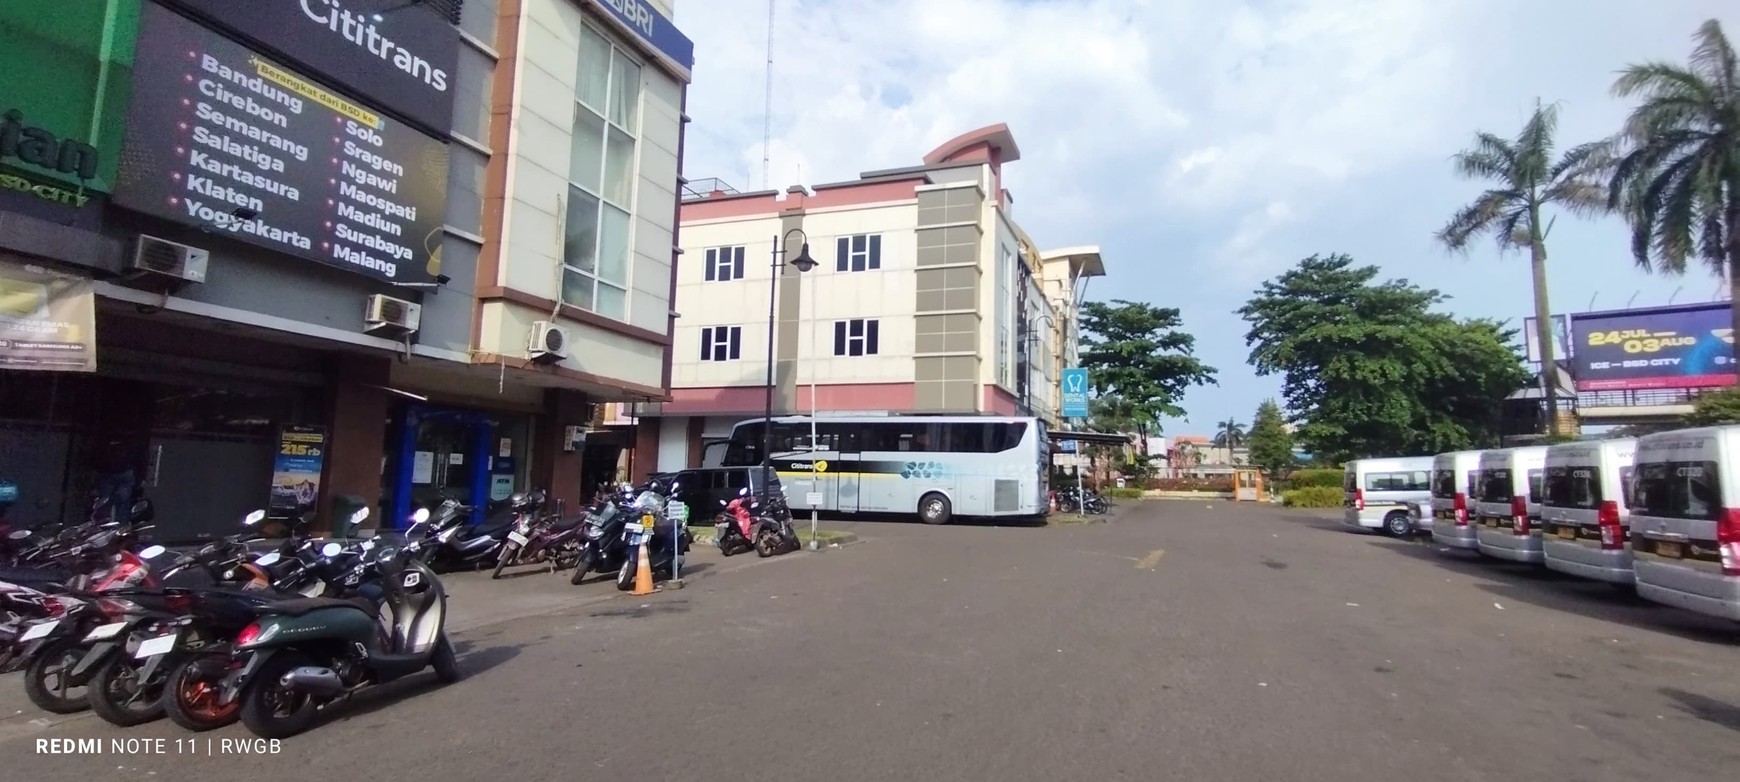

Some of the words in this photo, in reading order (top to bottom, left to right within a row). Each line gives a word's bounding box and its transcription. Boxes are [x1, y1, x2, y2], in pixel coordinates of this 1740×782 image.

[623, 0, 654, 38] BRI
[300, 0, 447, 92] Cititrans
[202, 54, 302, 114] Bandung
[260, 65, 318, 97] Berangkat
[319, 94, 340, 108] dari
[340, 102, 361, 117] BSD
[198, 79, 287, 128] Cirebon
[192, 126, 285, 172] Salatiga
[196, 102, 308, 160] Semarang
[345, 120, 383, 147] Solo
[190, 149, 299, 201] Kartasura
[341, 160, 397, 194] Ngawi
[343, 141, 403, 176] Sragen
[187, 174, 263, 212] Klaten
[340, 181, 416, 221] Maospati
[184, 198, 311, 250] Yogyakarta
[337, 202, 401, 236] Madiun
[333, 244, 396, 277] Malang
[335, 223, 413, 260] Surabaya
[1588, 331, 1622, 346] 24
[1621, 329, 1651, 339] JUL
[1624, 339, 1661, 353] 03
[1660, 336, 1696, 346] AUG
[1590, 362, 1610, 370] ICE
[1623, 360, 1648, 368] BSD
[1650, 358, 1681, 366] CITY
[280, 443, 309, 456] 215
